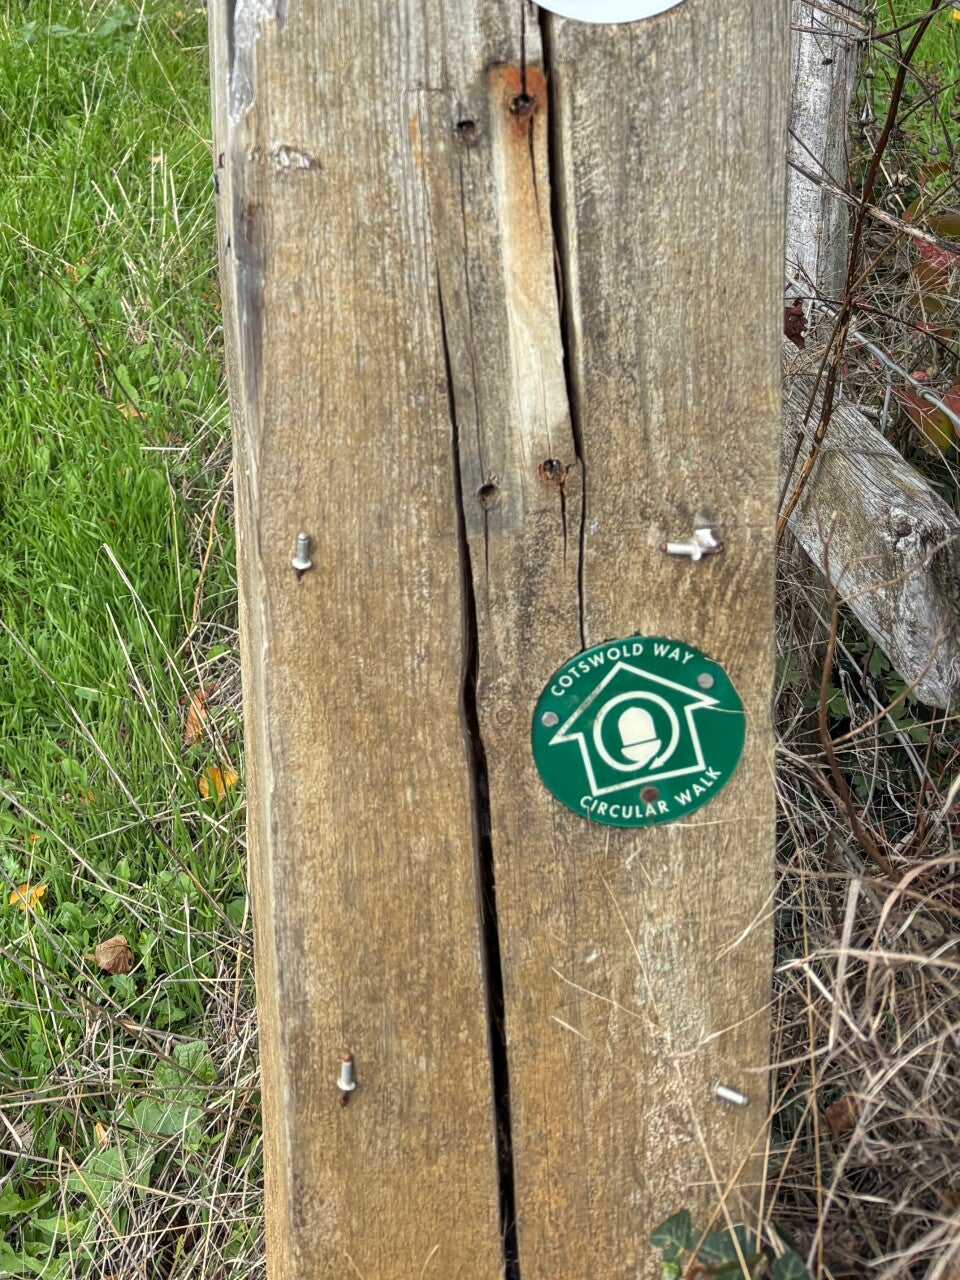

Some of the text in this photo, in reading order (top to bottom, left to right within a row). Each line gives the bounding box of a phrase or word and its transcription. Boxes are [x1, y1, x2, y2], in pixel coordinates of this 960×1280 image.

[550, 642, 695, 697] COTSWOLD WAY
[579, 766, 722, 819] CIRCULAR WALK
